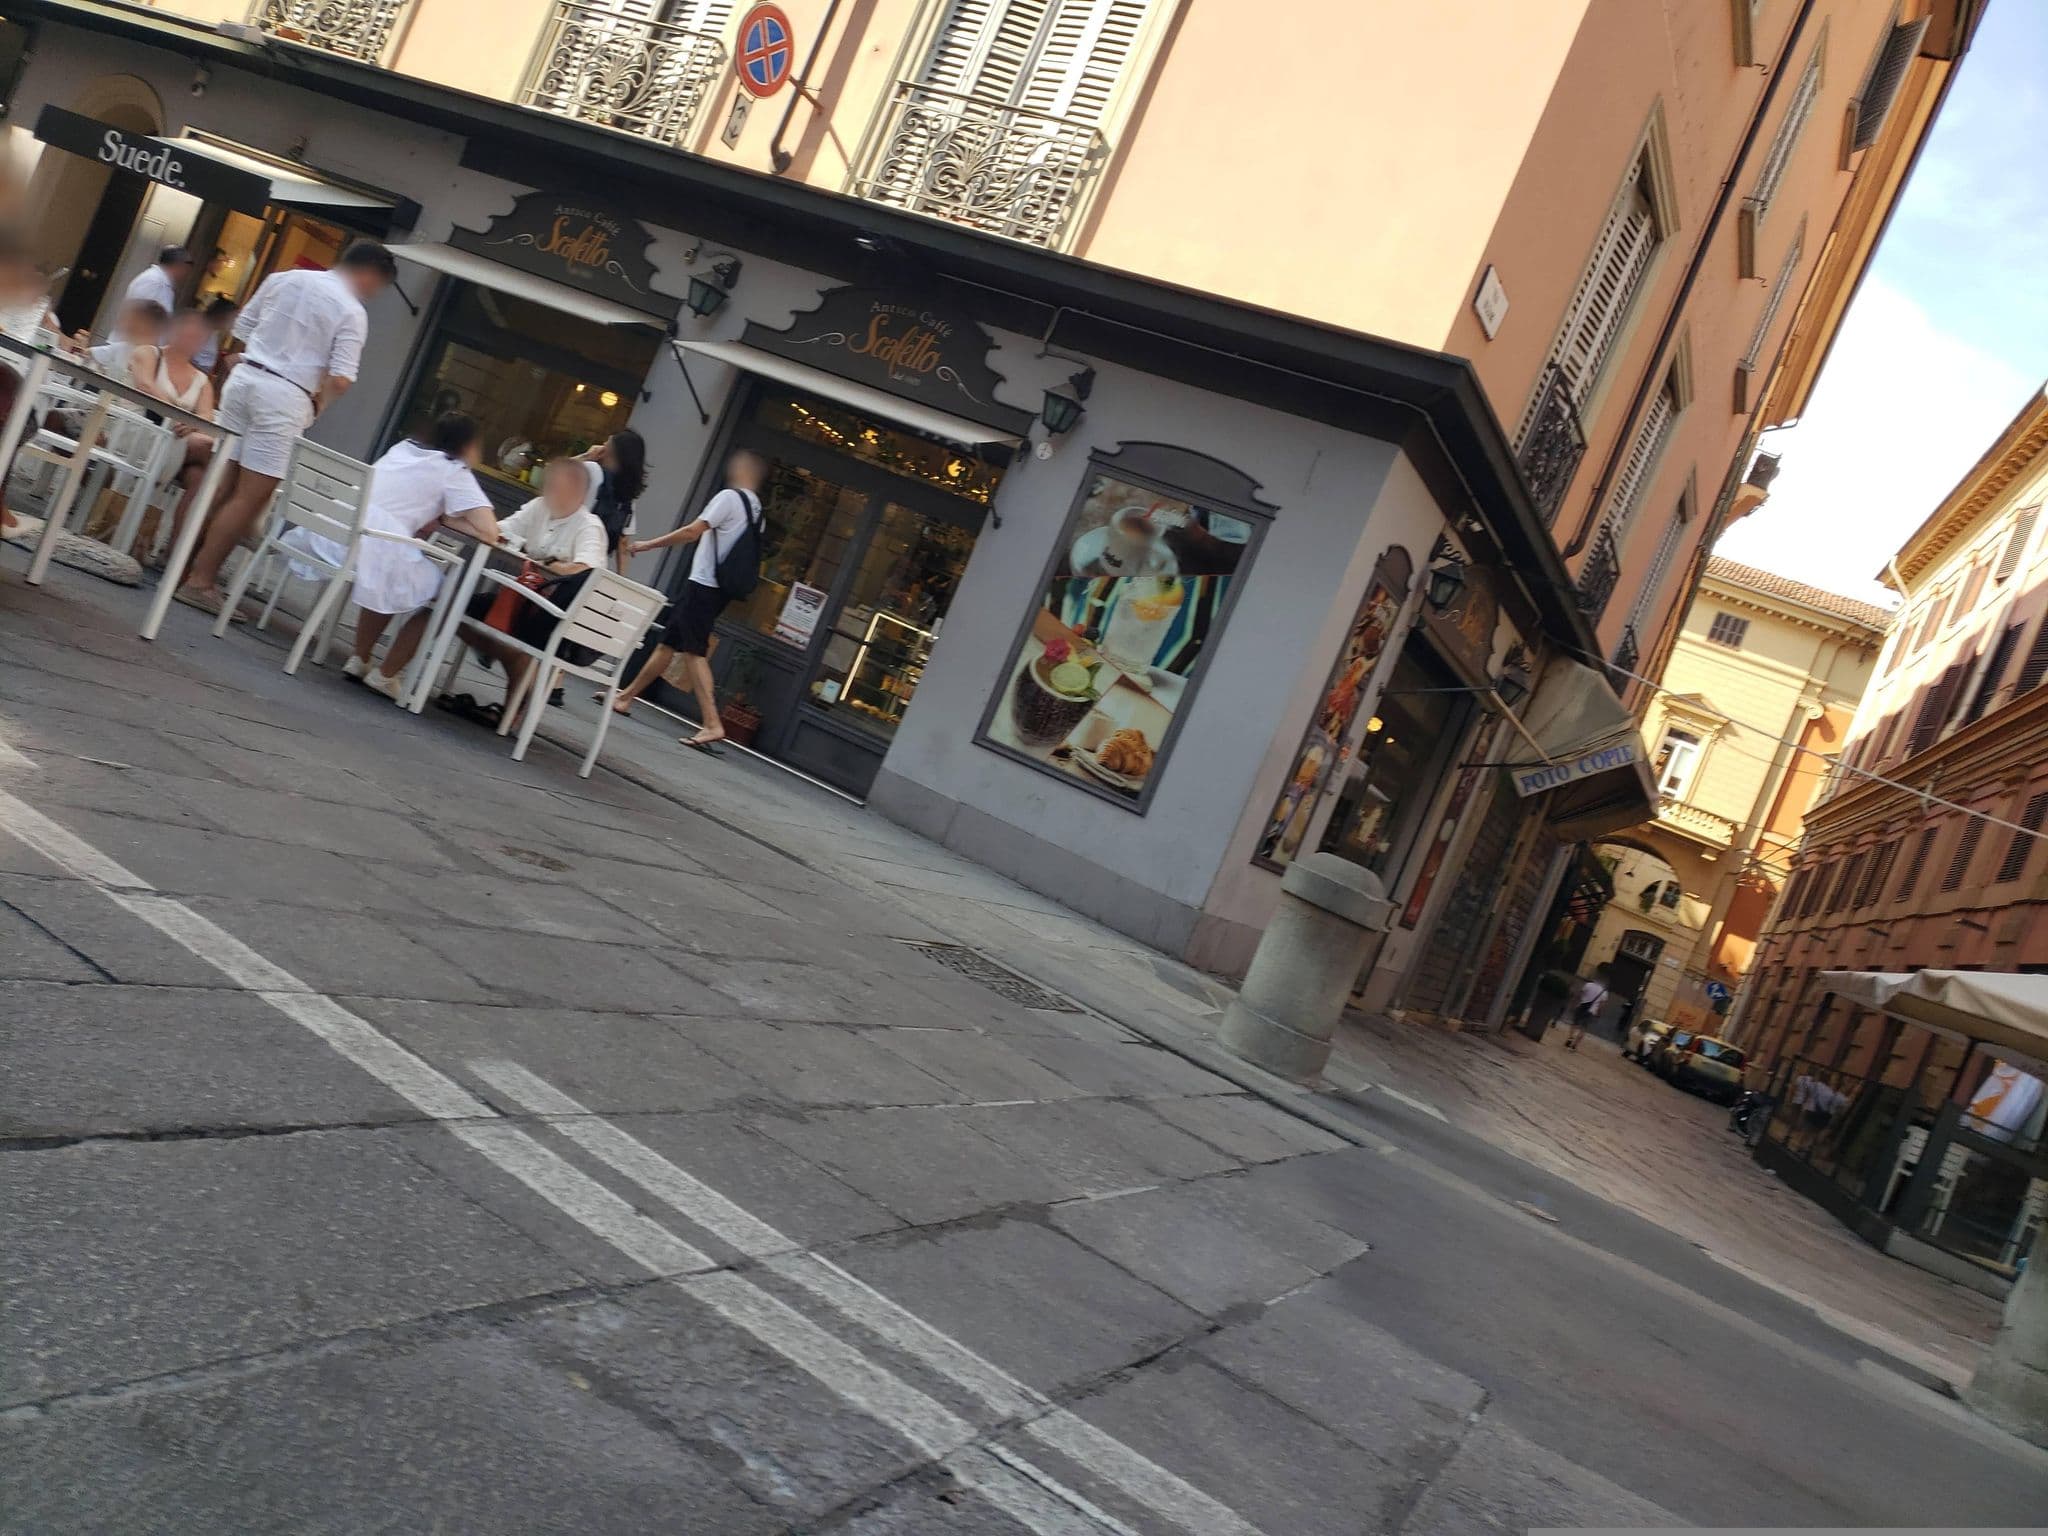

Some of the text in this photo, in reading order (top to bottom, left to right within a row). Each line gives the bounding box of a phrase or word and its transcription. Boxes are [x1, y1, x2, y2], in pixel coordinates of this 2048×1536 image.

[98, 129, 186, 188] Suede.
[1519, 744, 1635, 793] FOTO COPIE
